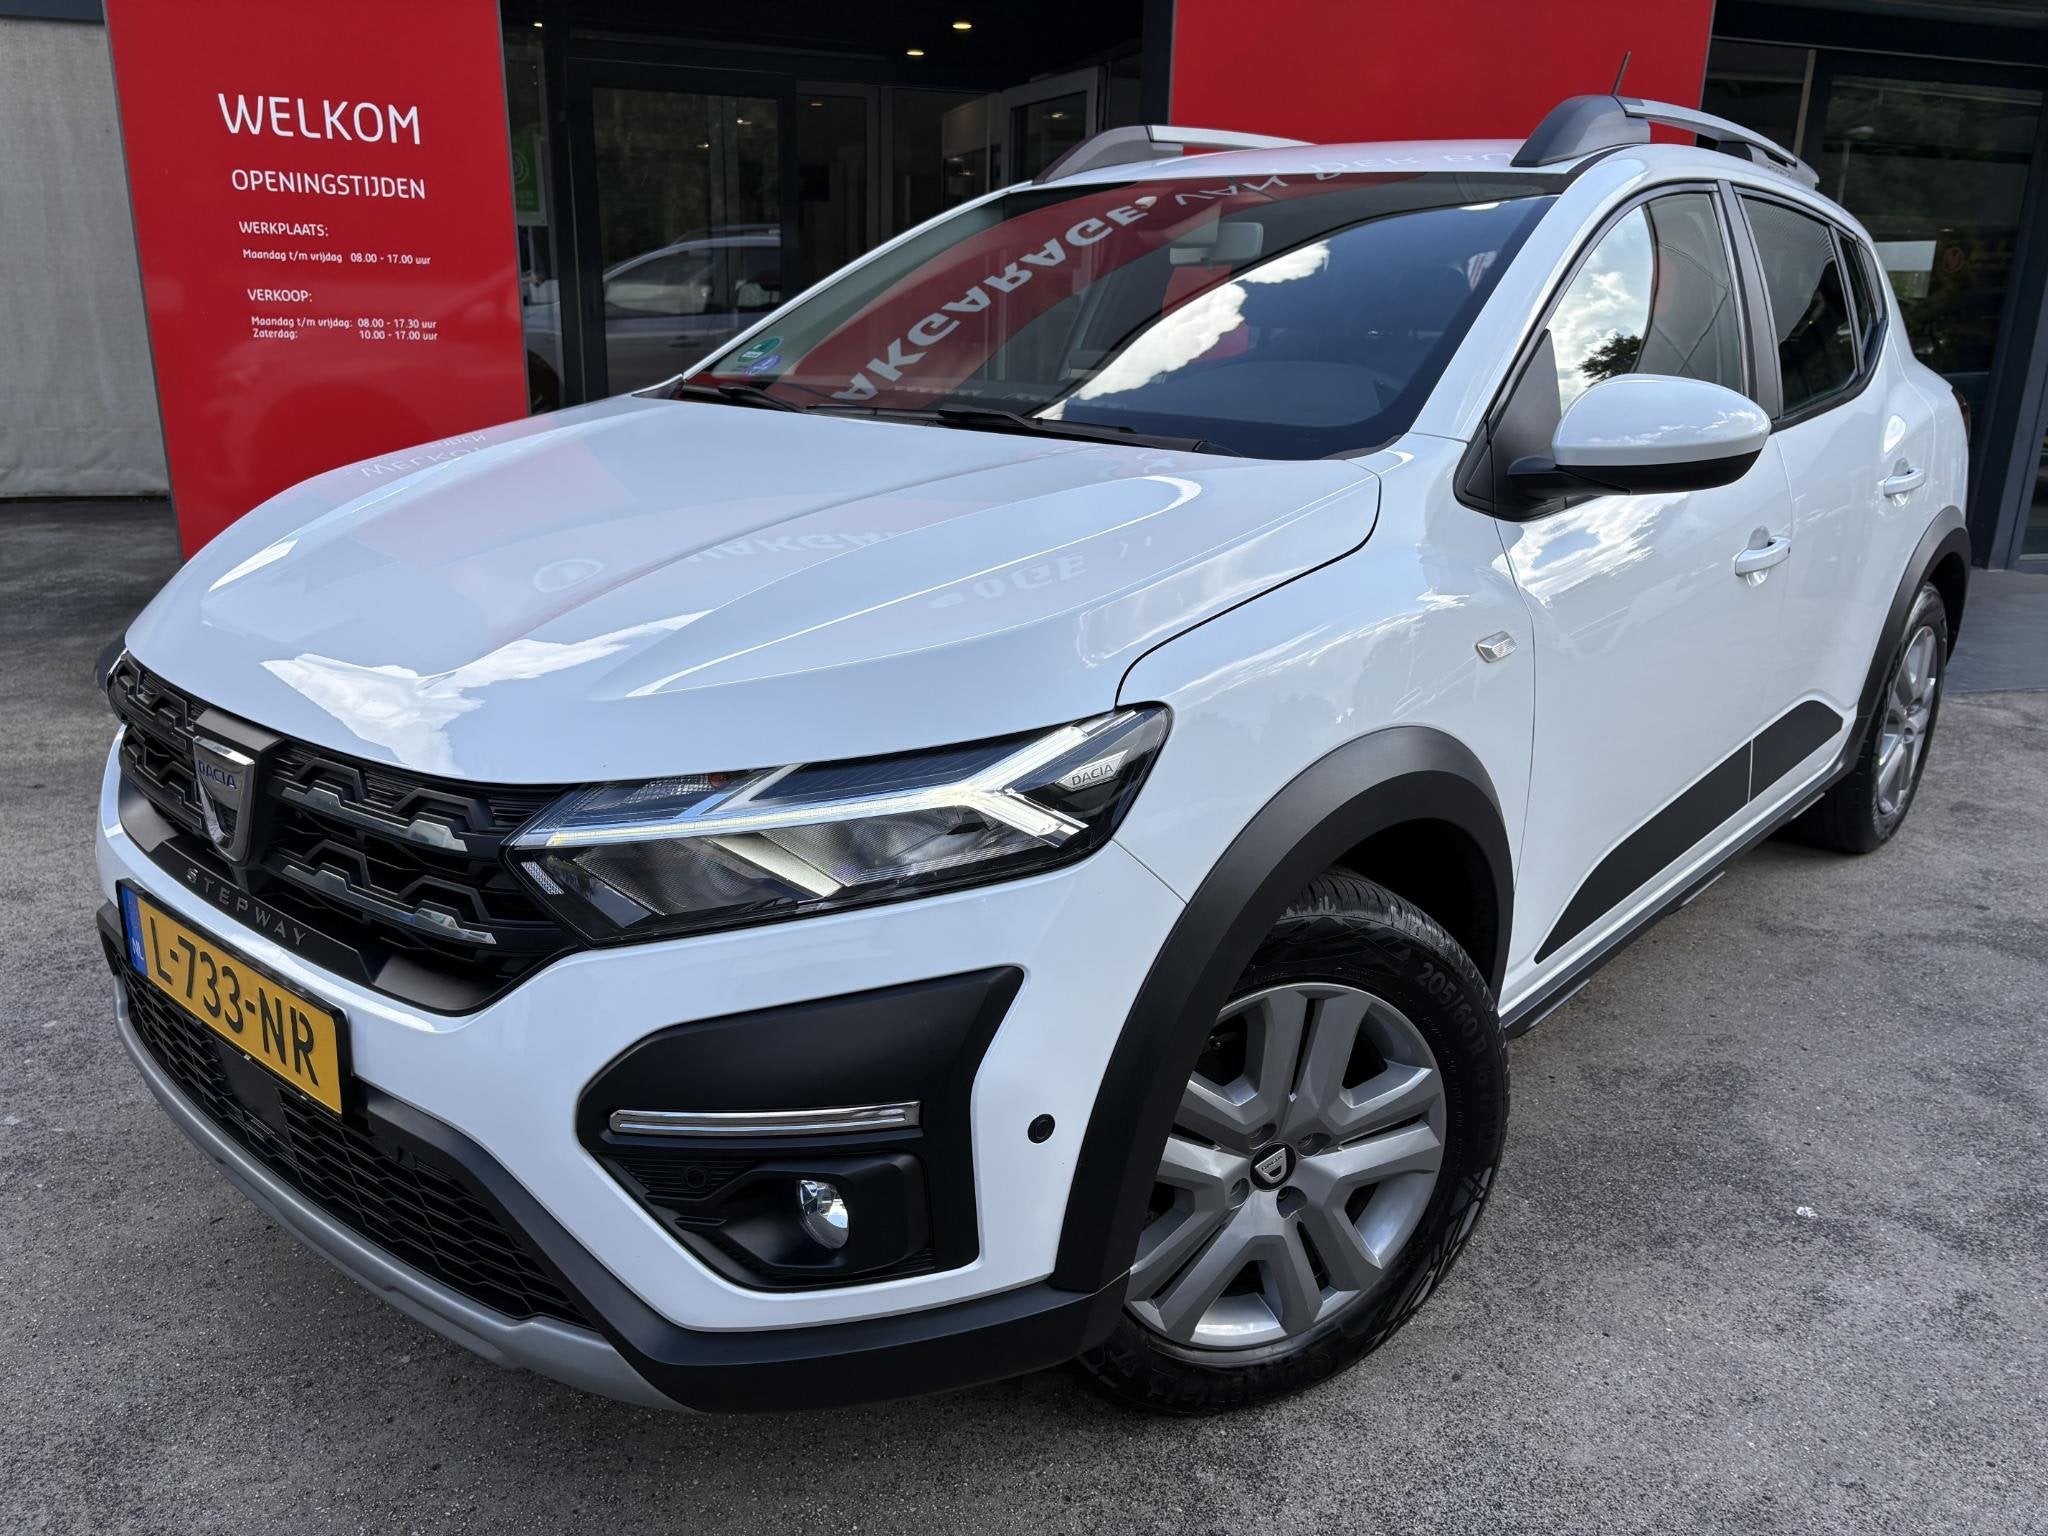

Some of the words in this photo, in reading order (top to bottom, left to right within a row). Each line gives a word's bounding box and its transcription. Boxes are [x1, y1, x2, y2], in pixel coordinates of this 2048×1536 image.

[217, 93, 421, 145] WELKOM
[231, 169, 426, 200] OPENINGSTIJDEN
[238, 221, 329, 237] WERKPLAATS:
[242, 249, 287, 262] Maandag
[288, 251, 308, 261] t/m
[310, 252, 343, 264] vrijdag
[350, 252, 378, 263] 08.00
[386, 254, 414, 265] 17.00
[415, 257, 431, 265] uur
[247, 288, 313, 302] VERKOOP:
[251, 316, 295, 329] Maandag
[296, 317, 316, 328] t/m
[317, 318, 353, 329] vrijdag:
[357, 318, 384, 328] 08.00
[393, 318, 420, 329] 17.30
[421, 321, 437, 329] uur
[253, 328, 299, 340] Zaterdag:
[359, 329, 386, 340] 10.00
[395, 330, 421, 341] 17.00
[422, 333, 438, 341] uur
[198, 760, 237, 790] DACIA
[1071, 764, 1113, 786] DACIA
[186, 868, 306, 946] STEPWAY
[132, 937, 144, 960] NL
[150, 916, 319, 1087] L-733-NR
[1414, 961, 1478, 1038] 205/60
